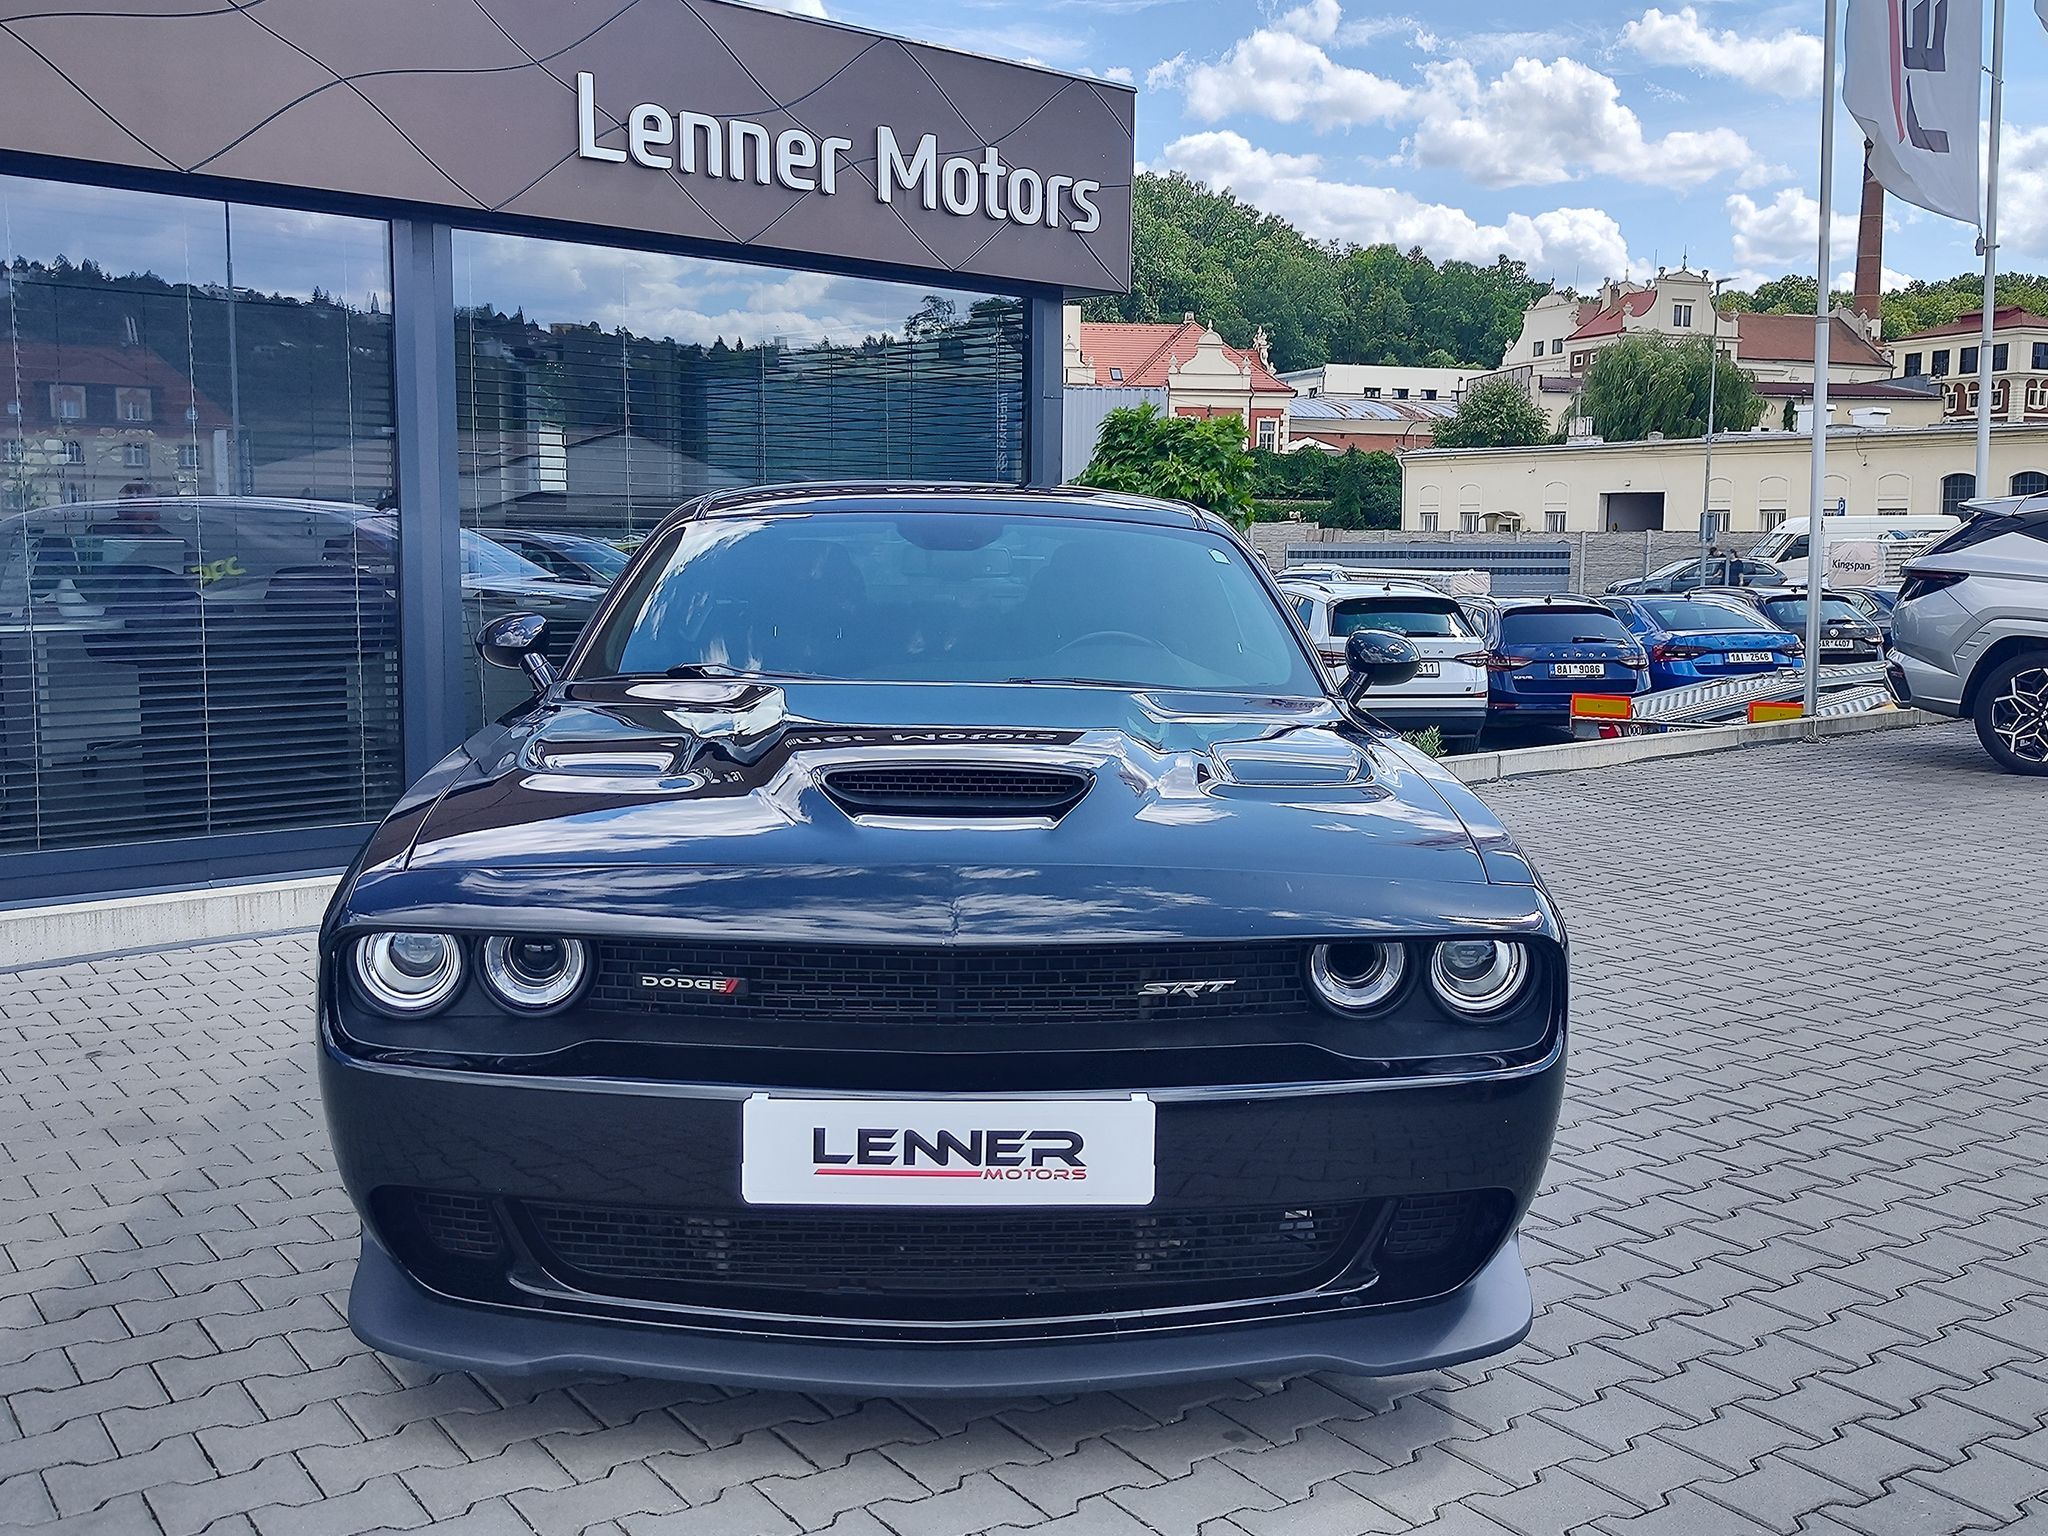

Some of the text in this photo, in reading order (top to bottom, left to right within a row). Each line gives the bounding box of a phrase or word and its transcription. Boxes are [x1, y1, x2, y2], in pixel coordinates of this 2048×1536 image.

[576, 71, 1101, 232] Lenner Motors
[1831, 559, 1871, 572] Kingspan
[641, 976, 728, 991] DODGE
[1137, 979, 1237, 998] SRT
[812, 1126, 1087, 1167] LENNER
[982, 1168, 1087, 1180] MOTORS
